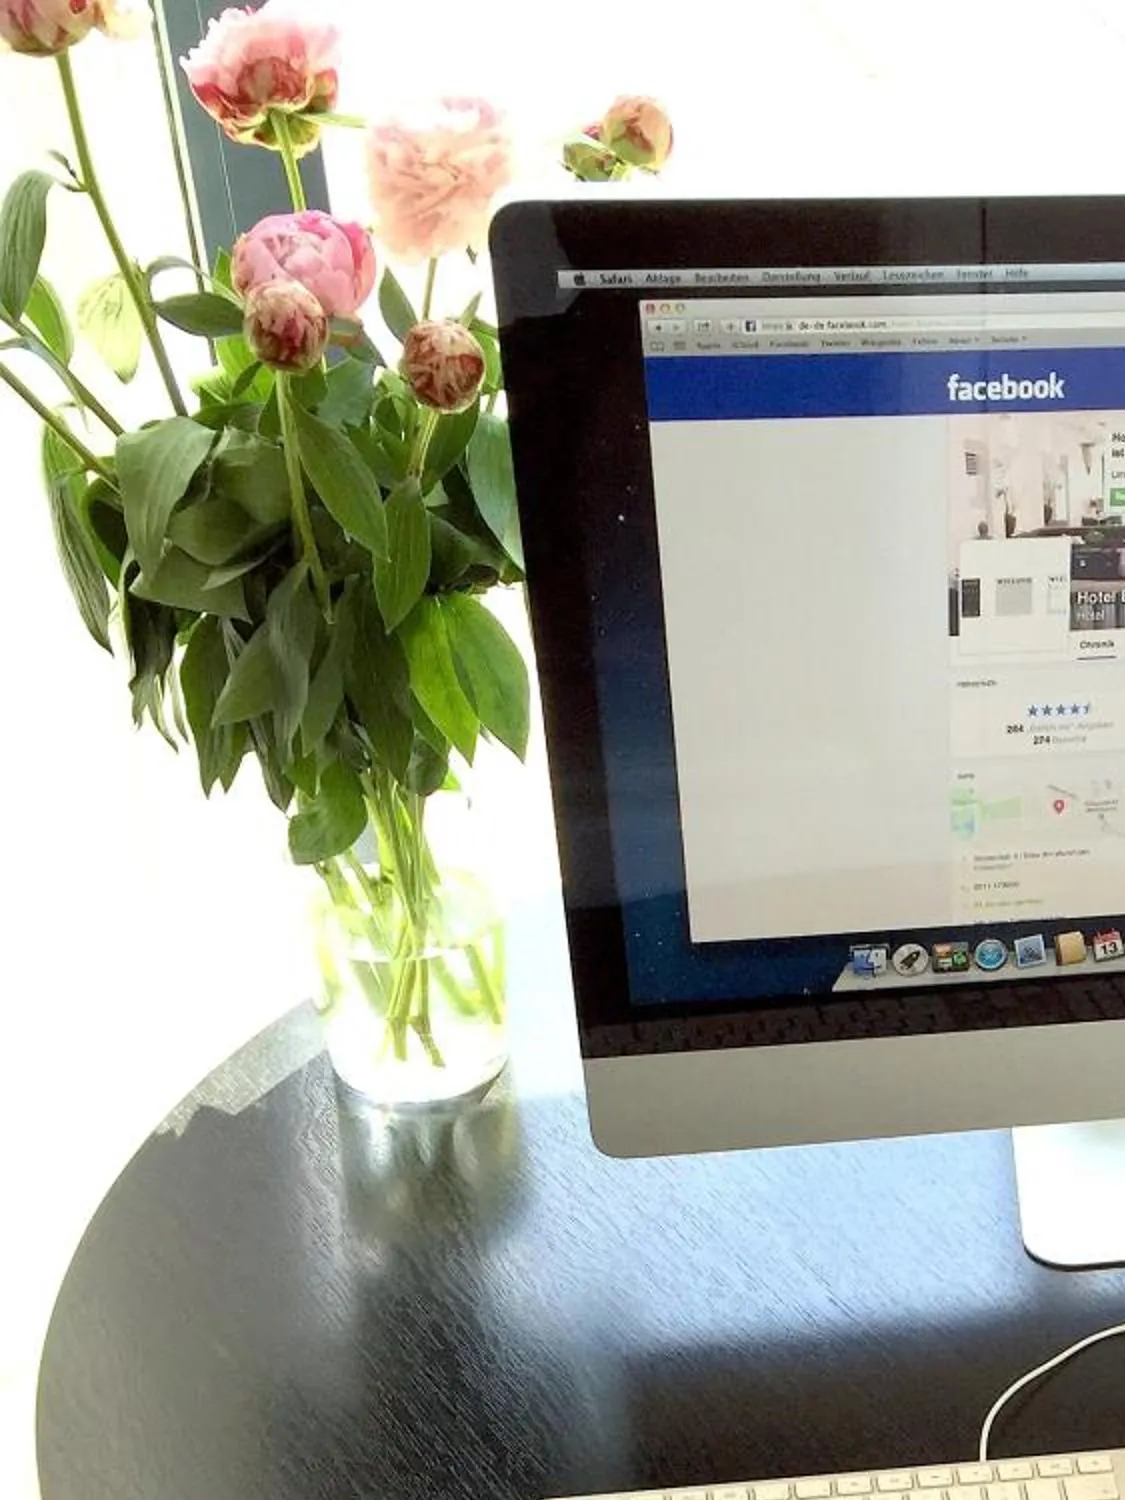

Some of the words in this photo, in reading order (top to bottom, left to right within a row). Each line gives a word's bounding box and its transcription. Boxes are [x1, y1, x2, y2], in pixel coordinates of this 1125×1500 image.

[600, 273, 633, 284] Safari
[946, 371, 1066, 402] facebook
[1077, 589, 1115, 605] Hotel
[1101, 941, 1119, 956] 13
